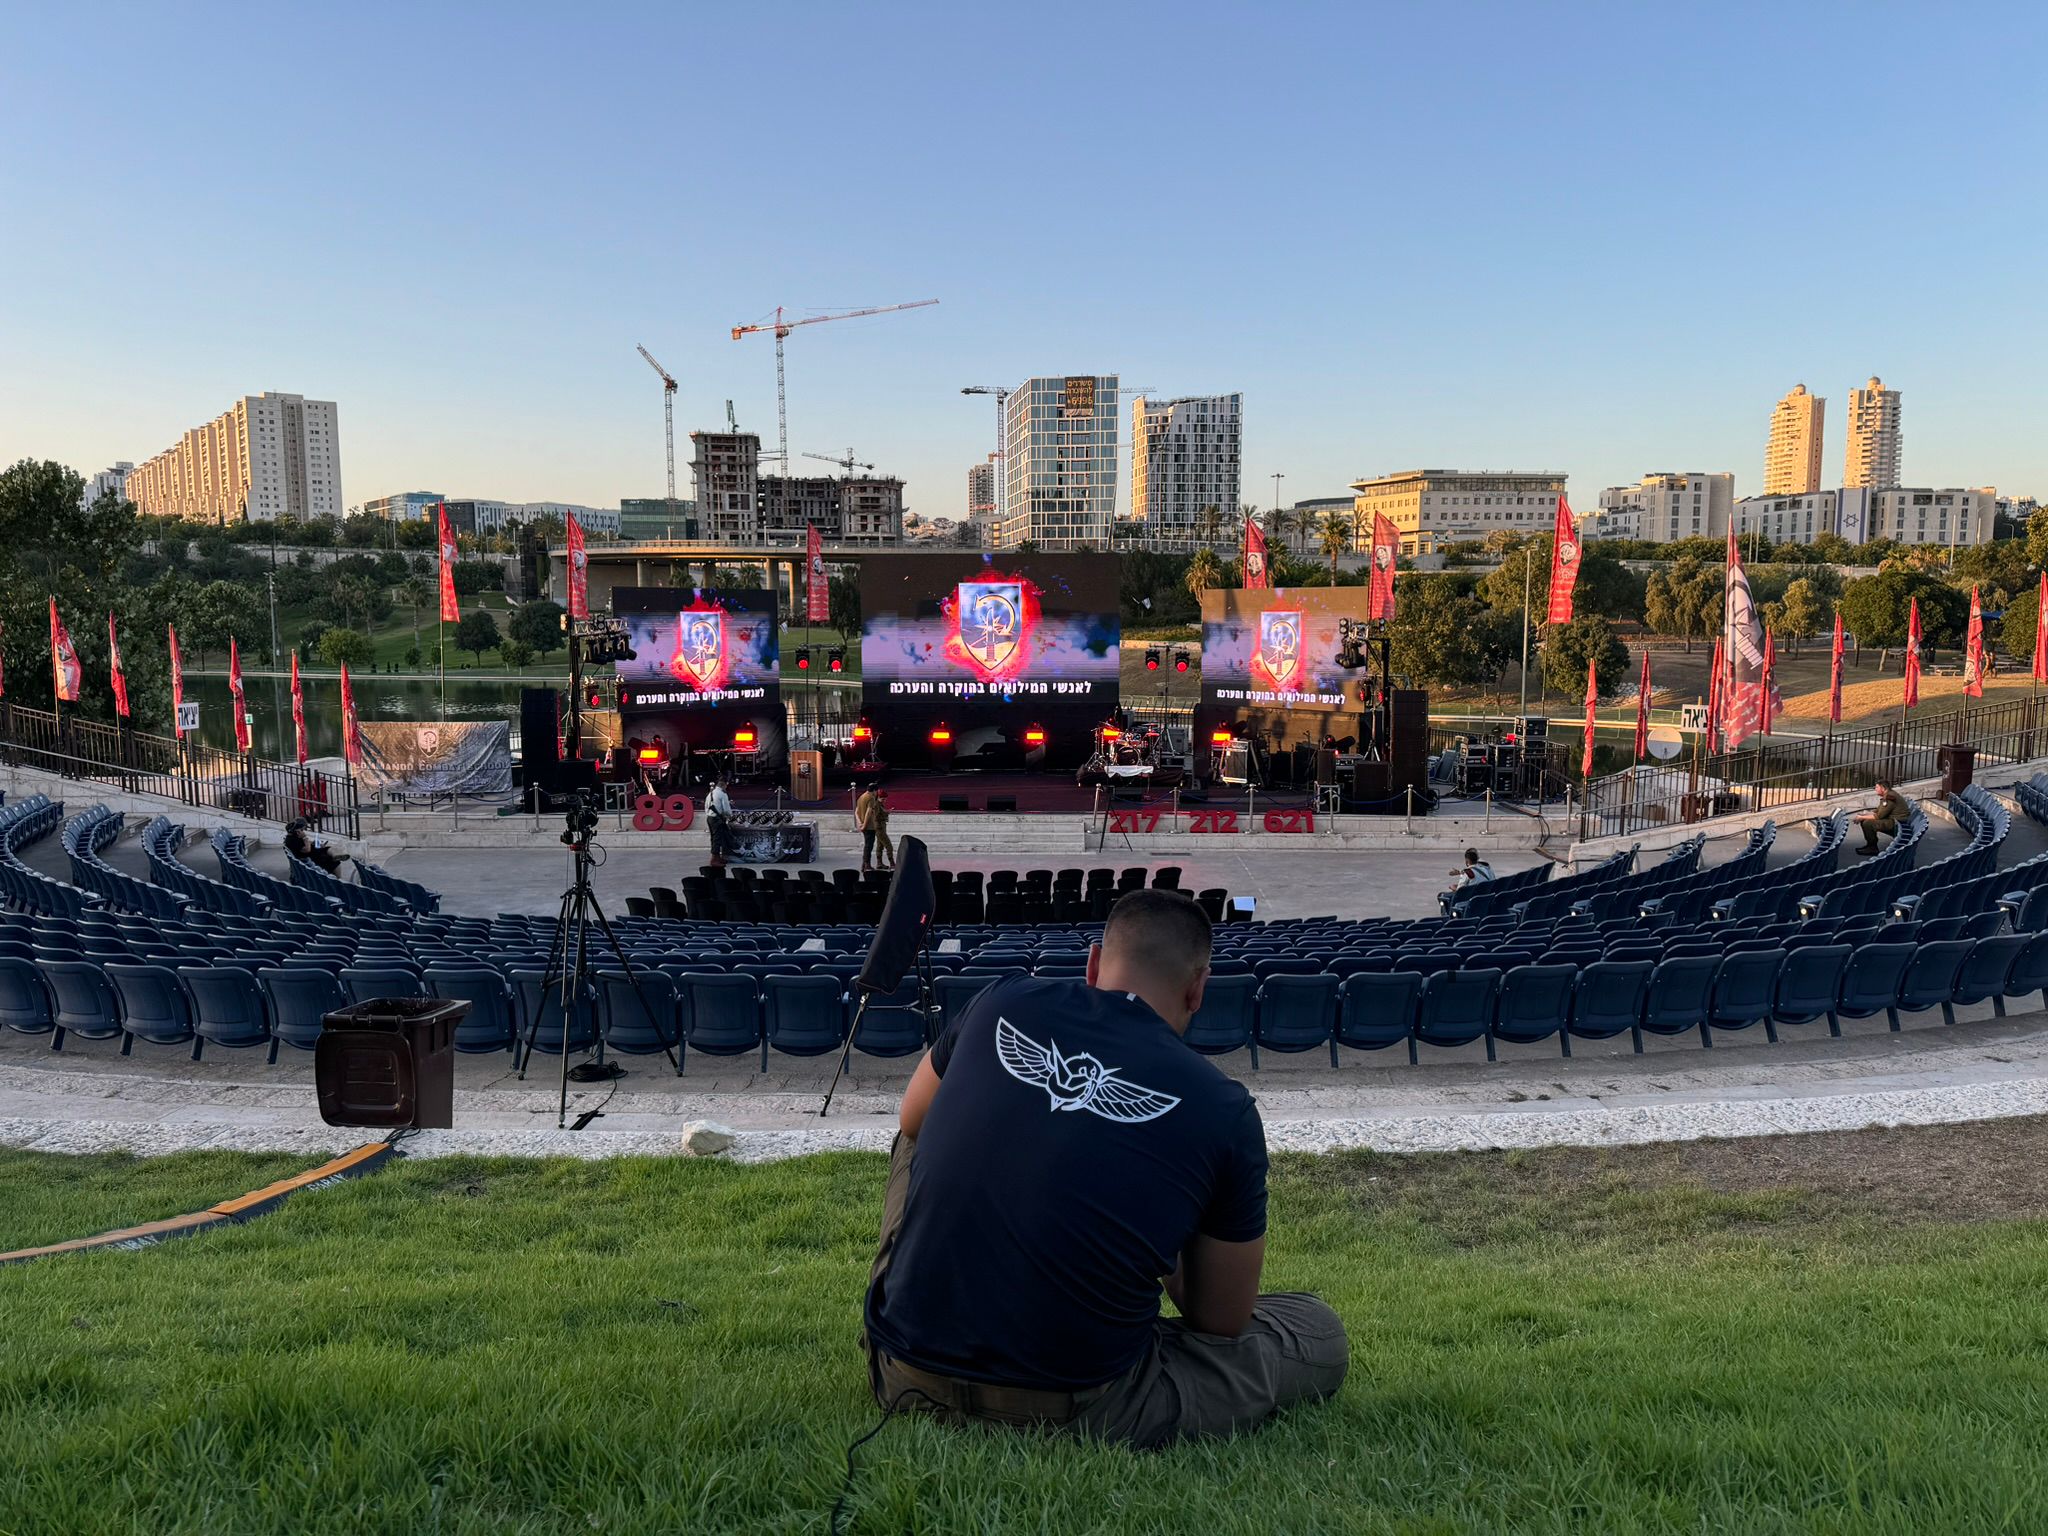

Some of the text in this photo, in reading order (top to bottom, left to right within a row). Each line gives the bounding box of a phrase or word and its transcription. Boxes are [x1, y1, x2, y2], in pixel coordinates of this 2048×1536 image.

[702, 689, 739, 702] המילואים
[741, 687, 765, 699] לאנשי
[890, 681, 1092, 697] לאנשי המילואים בהוקרה והערכה
[1277, 691, 1316, 704] המילואים
[1318, 693, 1346, 705] לאנשי
[178, 706, 198, 727] יציאה
[1684, 708, 1708, 728] ציאה
[632, 793, 695, 831] 89
[1109, 809, 1315, 833] 217 212 621
